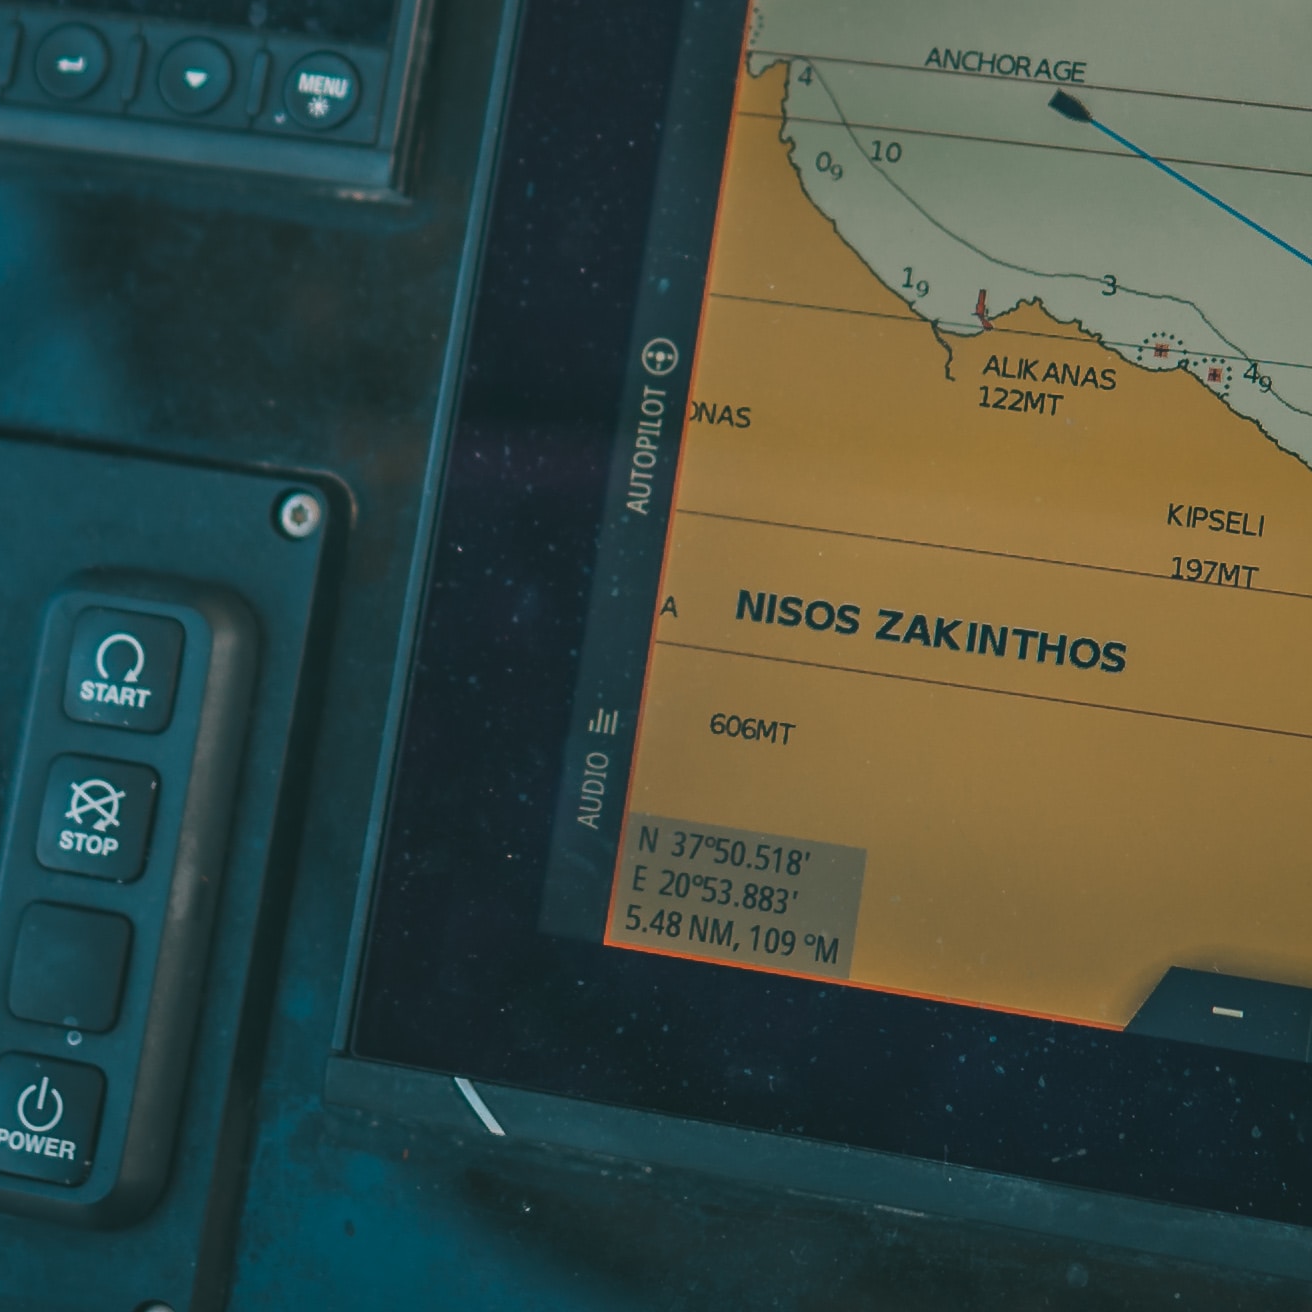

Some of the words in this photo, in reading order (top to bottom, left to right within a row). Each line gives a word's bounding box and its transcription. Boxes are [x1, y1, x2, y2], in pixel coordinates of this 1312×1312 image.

[797, 67, 813, 86] 4
[924, 47, 1087, 82] ANCHORAGE
[298, 72, 348, 98] MENU
[870, 141, 902, 163] 10
[1101, 275, 1118, 296] 3
[982, 355, 1118, 390] ALIKANAS
[978, 387, 1063, 416] 122MT
[626, 385, 667, 515] AUTOPILOT
[1166, 503, 1265, 537] KIPSELI
[1171, 557, 1260, 590] 197MT
[661, 596, 678, 618] A
[735, 590, 861, 635] NISOS
[875, 609, 1128, 673] ZAKINTHOS
[79, 679, 150, 708] START
[709, 712, 796, 745] 606MT
[577, 751, 609, 830] AUDIO
[59, 828, 119, 856] STOP
[638, 826, 659, 854] N
[670, 831, 811, 876] 37°50.518'
[632, 866, 646, 891] E
[658, 870, 799, 915] 20°53.883'
[625, 904, 682, 938] 5.48
[688, 915, 740, 953] NM,
[749, 924, 795, 955] 109
